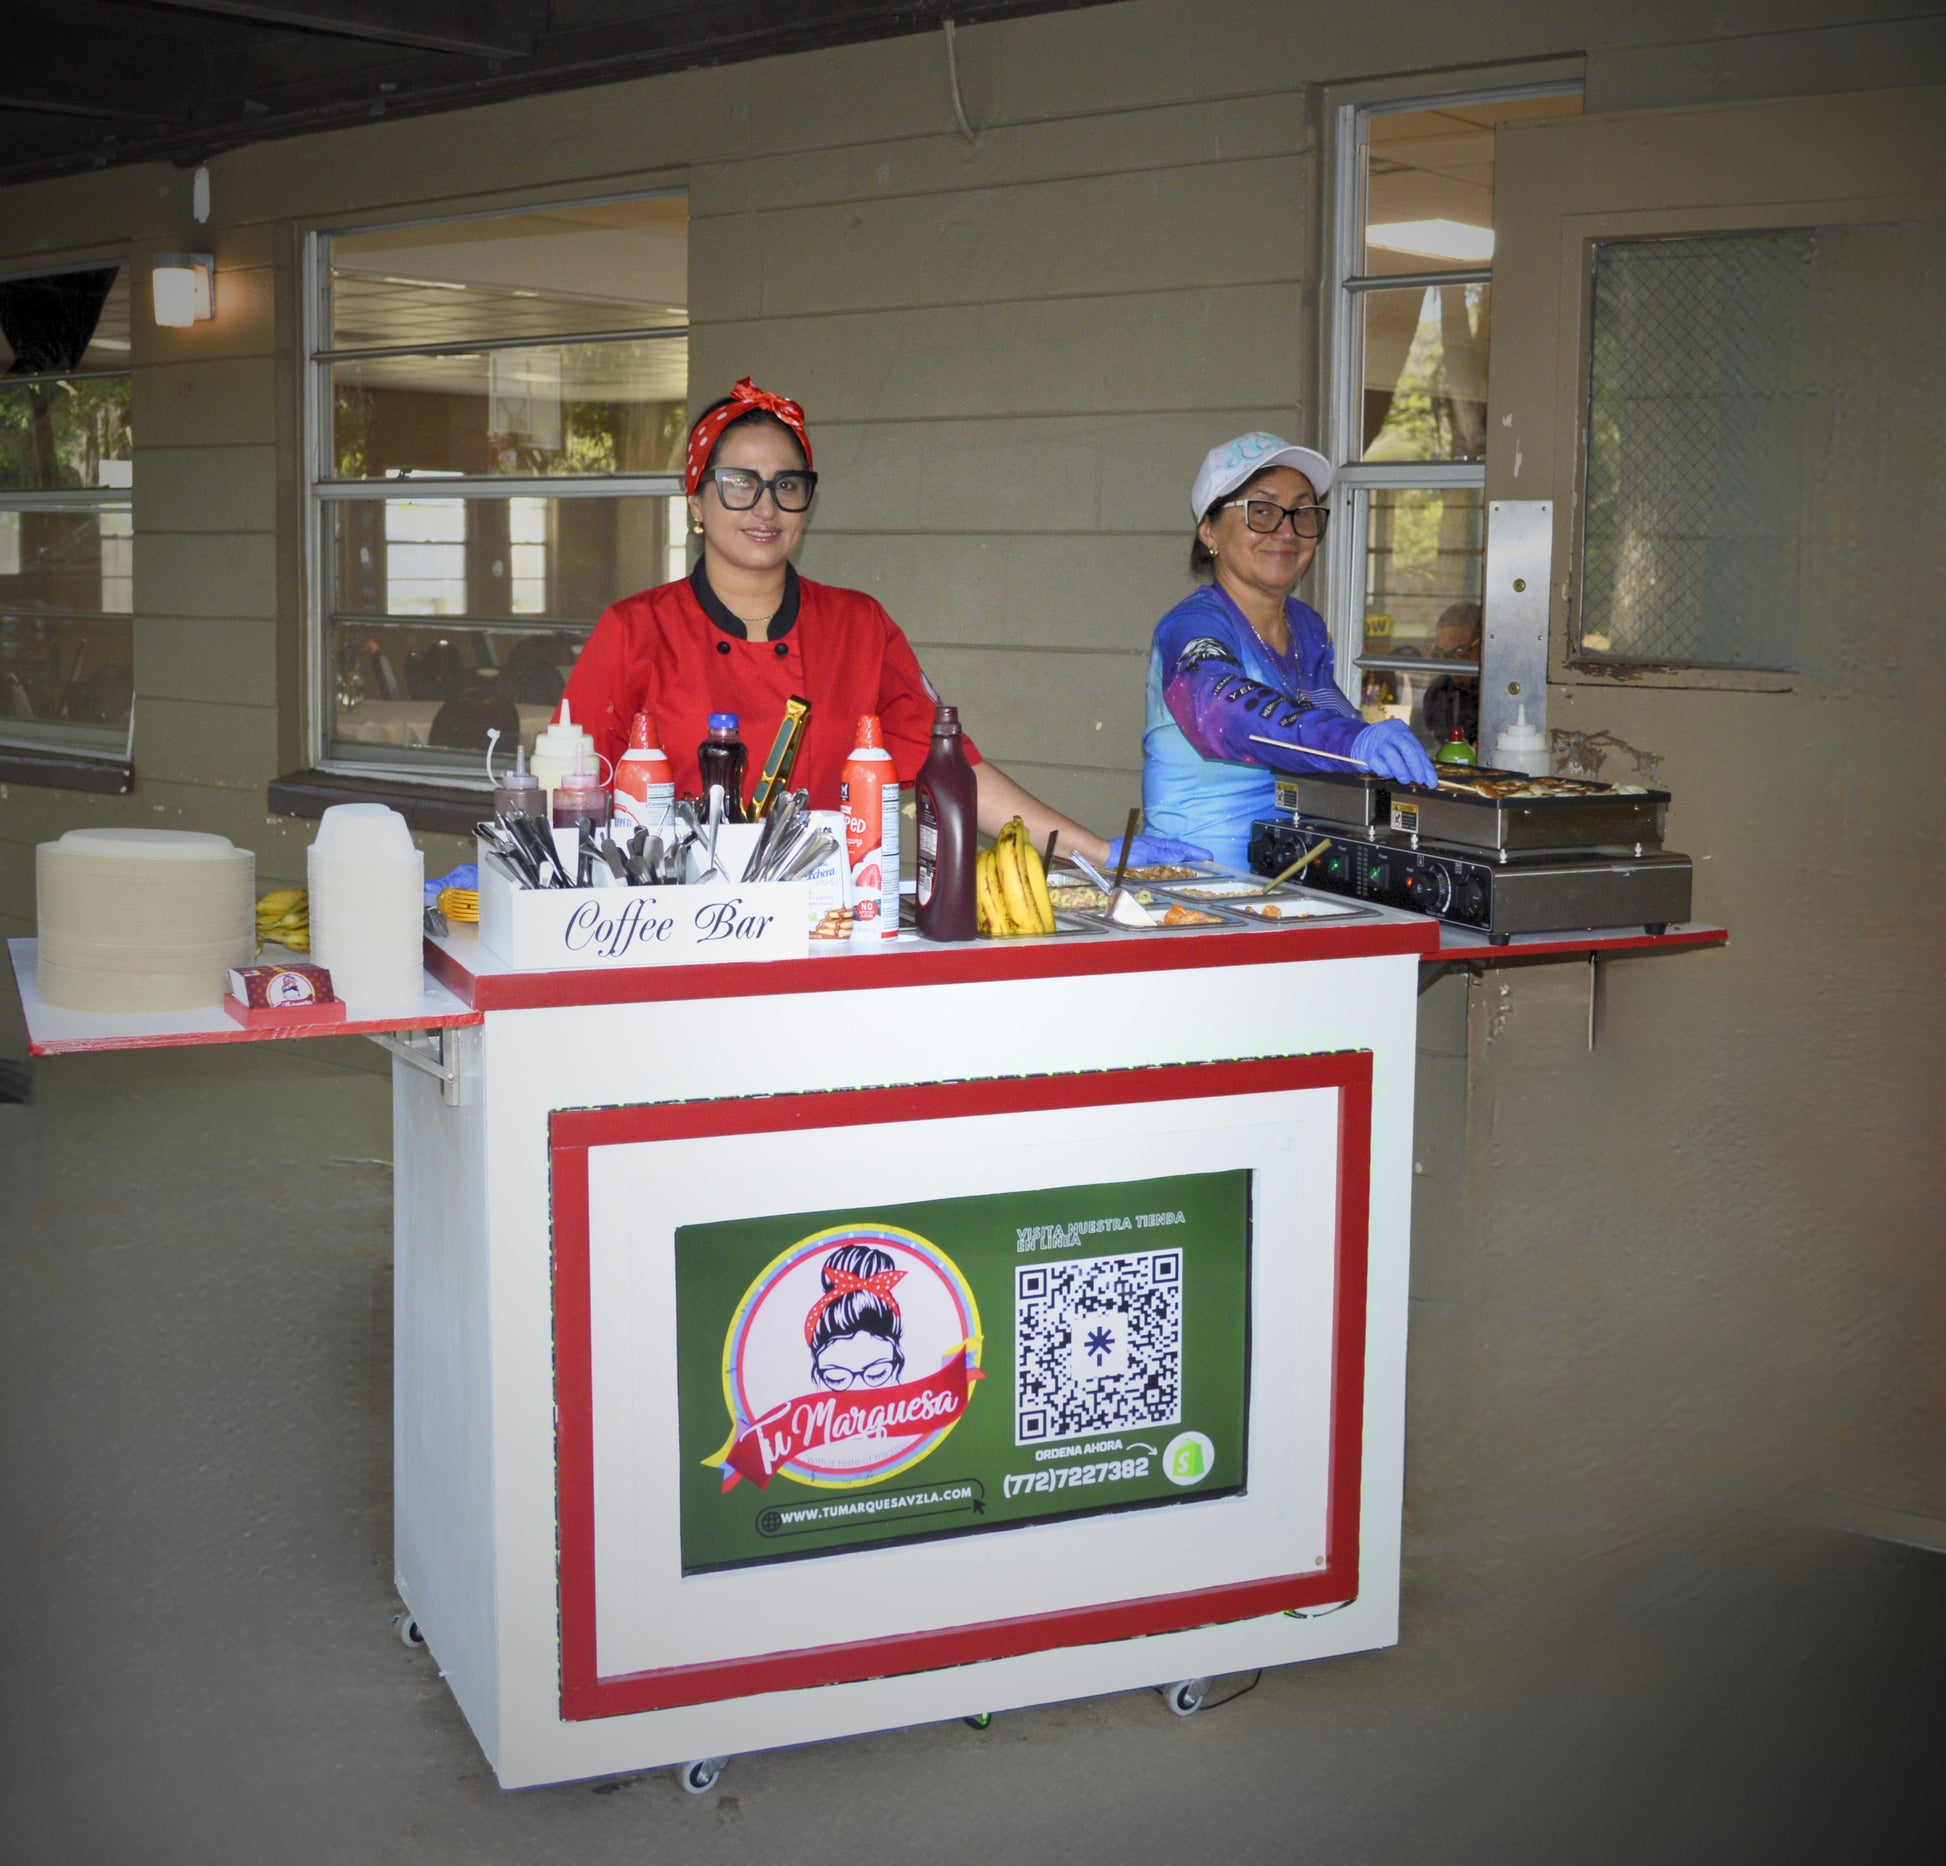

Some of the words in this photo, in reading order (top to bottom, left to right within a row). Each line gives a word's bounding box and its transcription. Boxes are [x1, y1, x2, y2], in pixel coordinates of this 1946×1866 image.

[861, 902, 873, 911] NO
[565, 898, 674, 958] Coffee
[694, 898, 774, 943] Bar
[1016, 1224, 1065, 1243] VISITA
[1067, 1216, 1133, 1236] NUESTRA
[1135, 1210, 1186, 1229] TIENDA
[1016, 1238, 1036, 1253] EN
[739, 1400, 793, 1476] Tu
[791, 1390, 960, 1447] Marquesa
[1035, 1443, 1083, 1461] ORDENA
[1083, 1438, 1124, 1455] AHORA
[1003, 1457, 1150, 1498] (772)7227382
[780, 1486, 972, 1525] WWW.TUMARQUESAVZLA.COM
